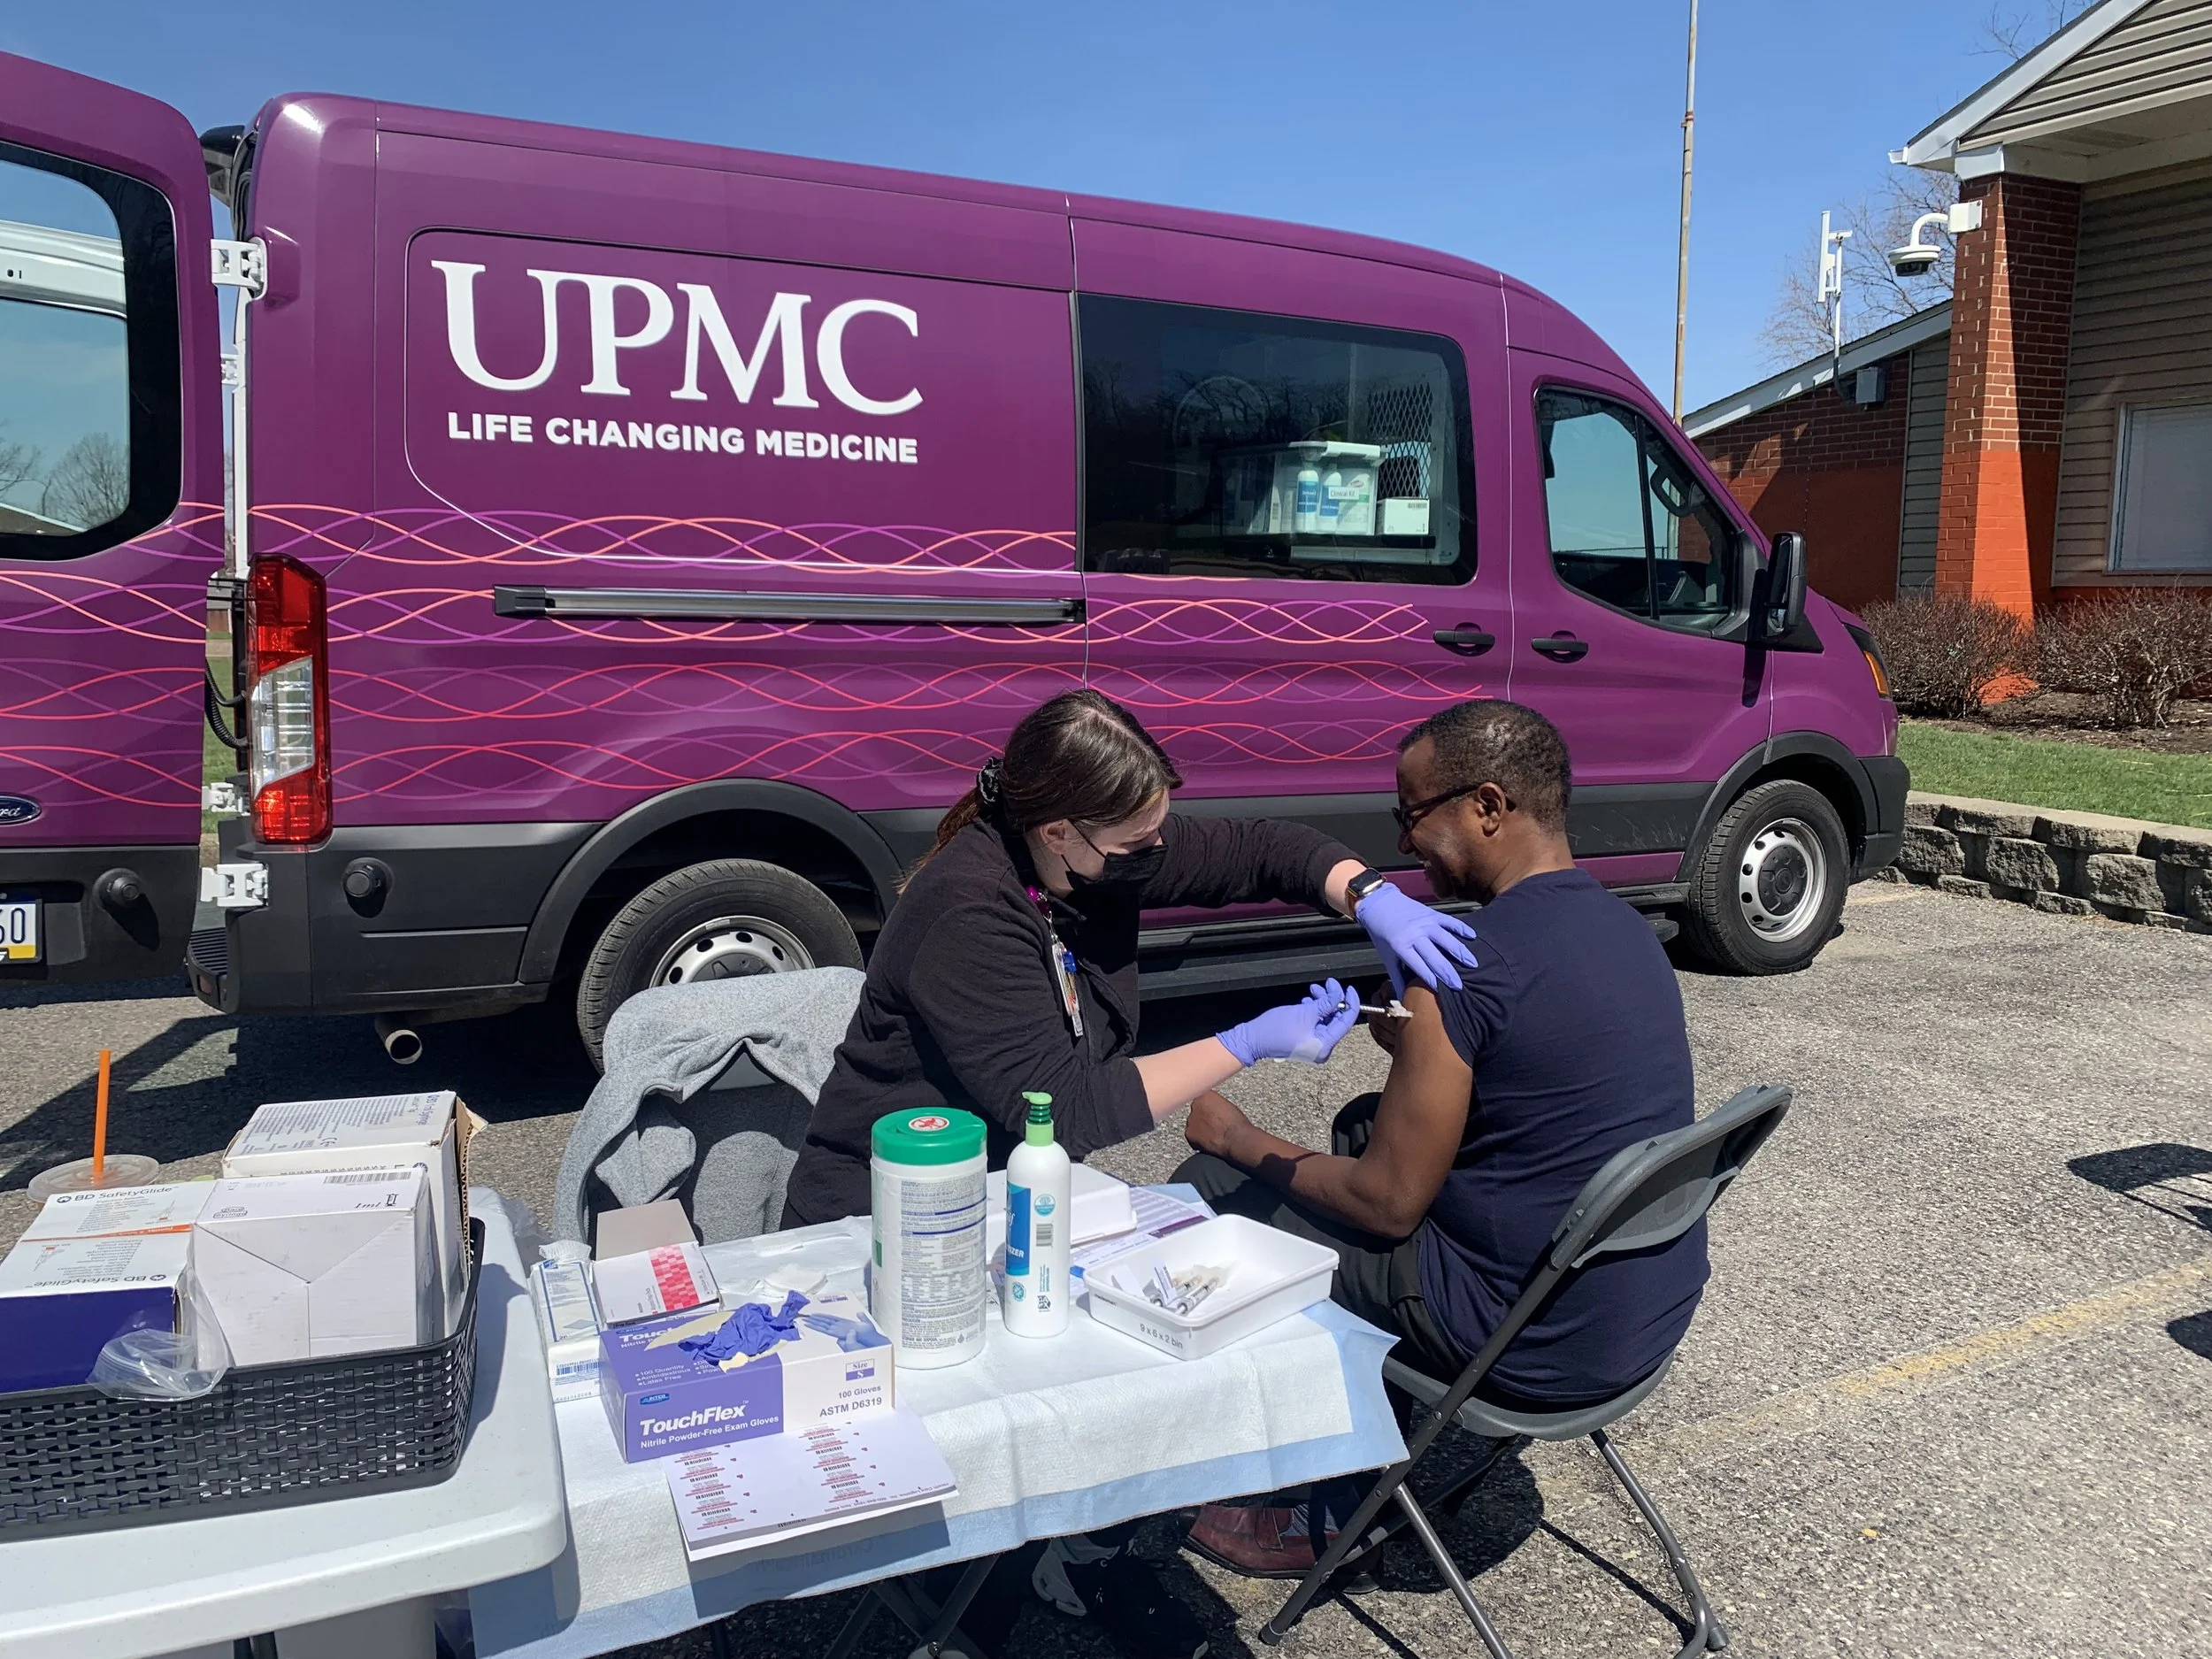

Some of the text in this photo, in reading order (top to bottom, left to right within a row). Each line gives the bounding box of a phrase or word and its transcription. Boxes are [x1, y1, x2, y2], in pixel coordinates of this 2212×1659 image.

[431, 260, 924, 416] UPMC
[448, 412, 918, 464] LIFE CHANGING MEDICINE
[1153, 1329, 1157, 1338] 6
[1171, 1338, 1183, 1349] bin
[655, 1364, 685, 1373] Quantity
[854, 1386, 881, 1395] Gloves
[819, 1397, 882, 1417] ASTM D6319
[641, 1416, 780, 1449] Nitrile Powder-Free Exam Gloves
